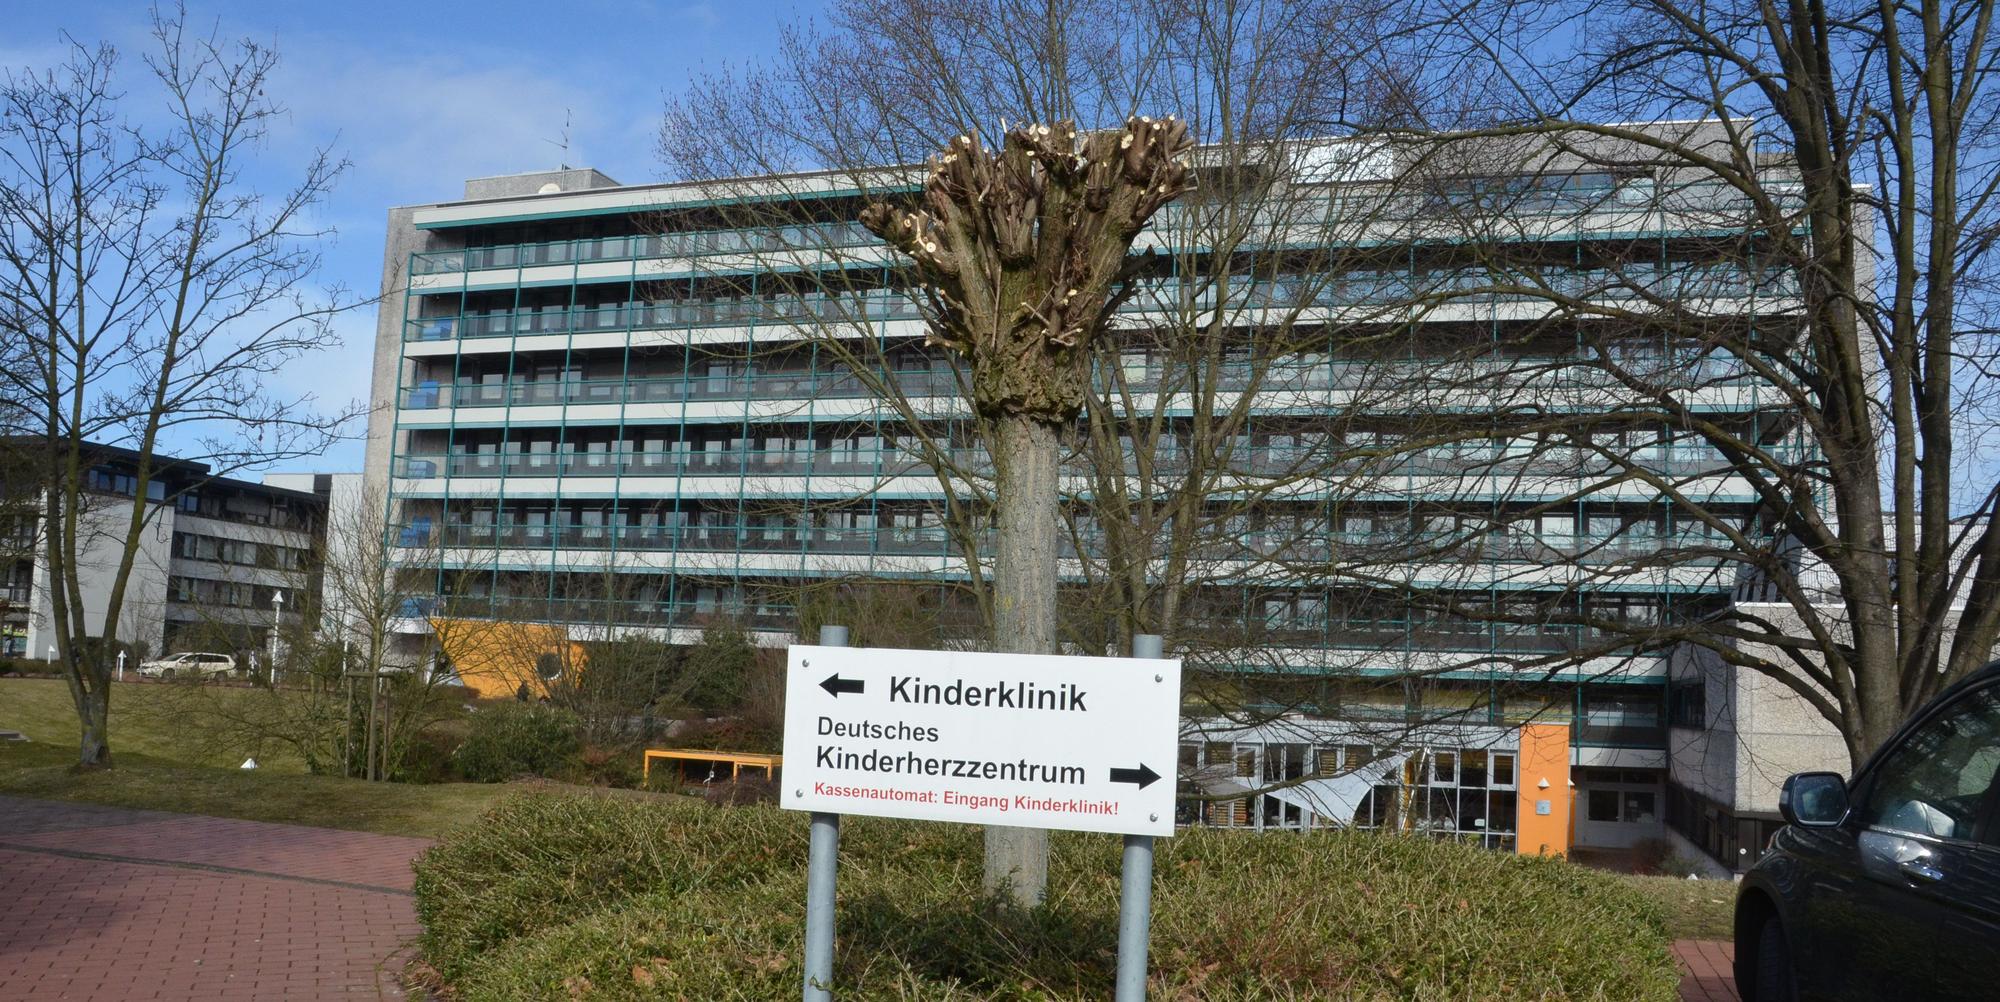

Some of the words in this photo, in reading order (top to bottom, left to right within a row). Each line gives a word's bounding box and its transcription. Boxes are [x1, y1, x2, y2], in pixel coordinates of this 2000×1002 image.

[890, 676, 1088, 712] Kinderklinik
[817, 716, 940, 742] Deutsches
[815, 745, 1086, 785] Kinderherzzentrum
[814, 782, 938, 804] Kassenautomat:
[943, 790, 1009, 812] Eingang
[1014, 795, 1119, 815] Kinderklinik!
